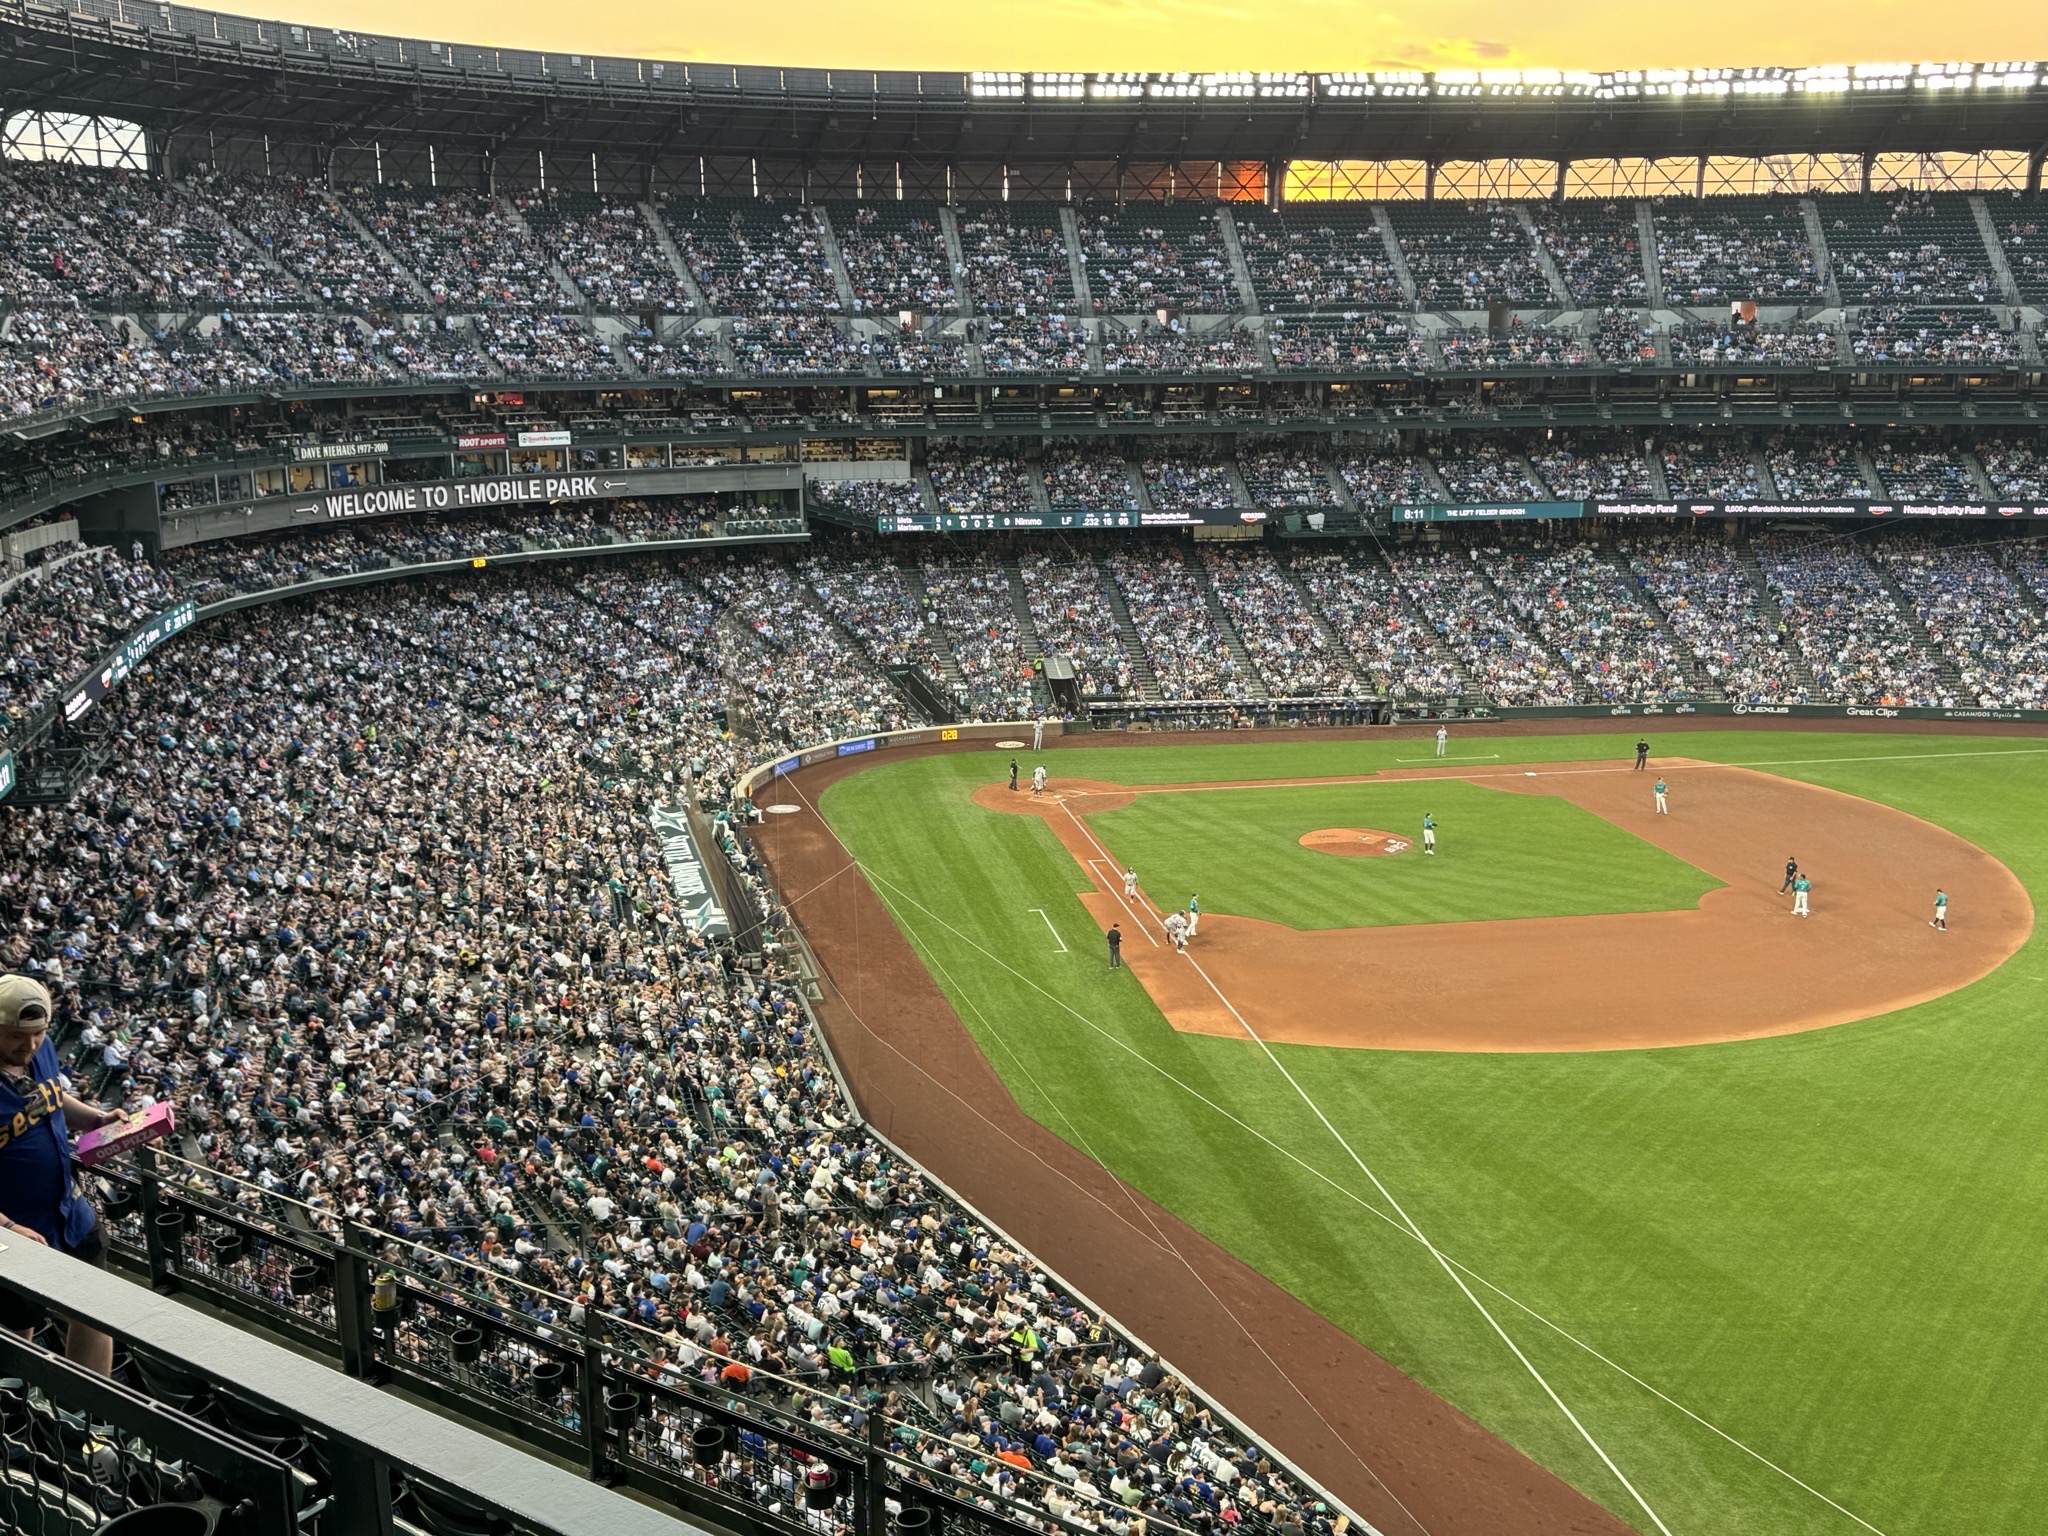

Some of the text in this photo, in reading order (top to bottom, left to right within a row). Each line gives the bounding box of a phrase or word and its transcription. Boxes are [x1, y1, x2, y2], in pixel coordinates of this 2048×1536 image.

[459, 437, 505, 447] ROOT SPORTS
[301, 442, 388, 460] DAVE NIEHAUS 1977-2010
[325, 476, 598, 518] WELCOME TO T-MOBILE PARK
[1403, 509, 1424, 519] 8:11
[1598, 504, 1677, 514] Housing Equity Fund
[1690, 505, 1715, 513] amazon
[1748, 505, 1780, 513] affordable
[1780, 505, 1802, 513] homes
[1820, 505, 1855, 513] hometown
[1868, 505, 1893, 513] amazon
[1903, 505, 1986, 515] Housing Equity Fund
[1998, 507, 2023, 515] amazon
[896, 516, 912, 524] Mets
[960, 519, 994, 528] 0 0 2
[1015, 517, 1042, 526] Nimmo
[1061, 516, 1072, 525] LF
[1643, 706, 1664, 715] Corona
[1846, 707, 1898, 718] Great Clips
[96, 1128, 159, 1160] ODD PIZZA
[1089, 1328, 1101, 1342] 44
